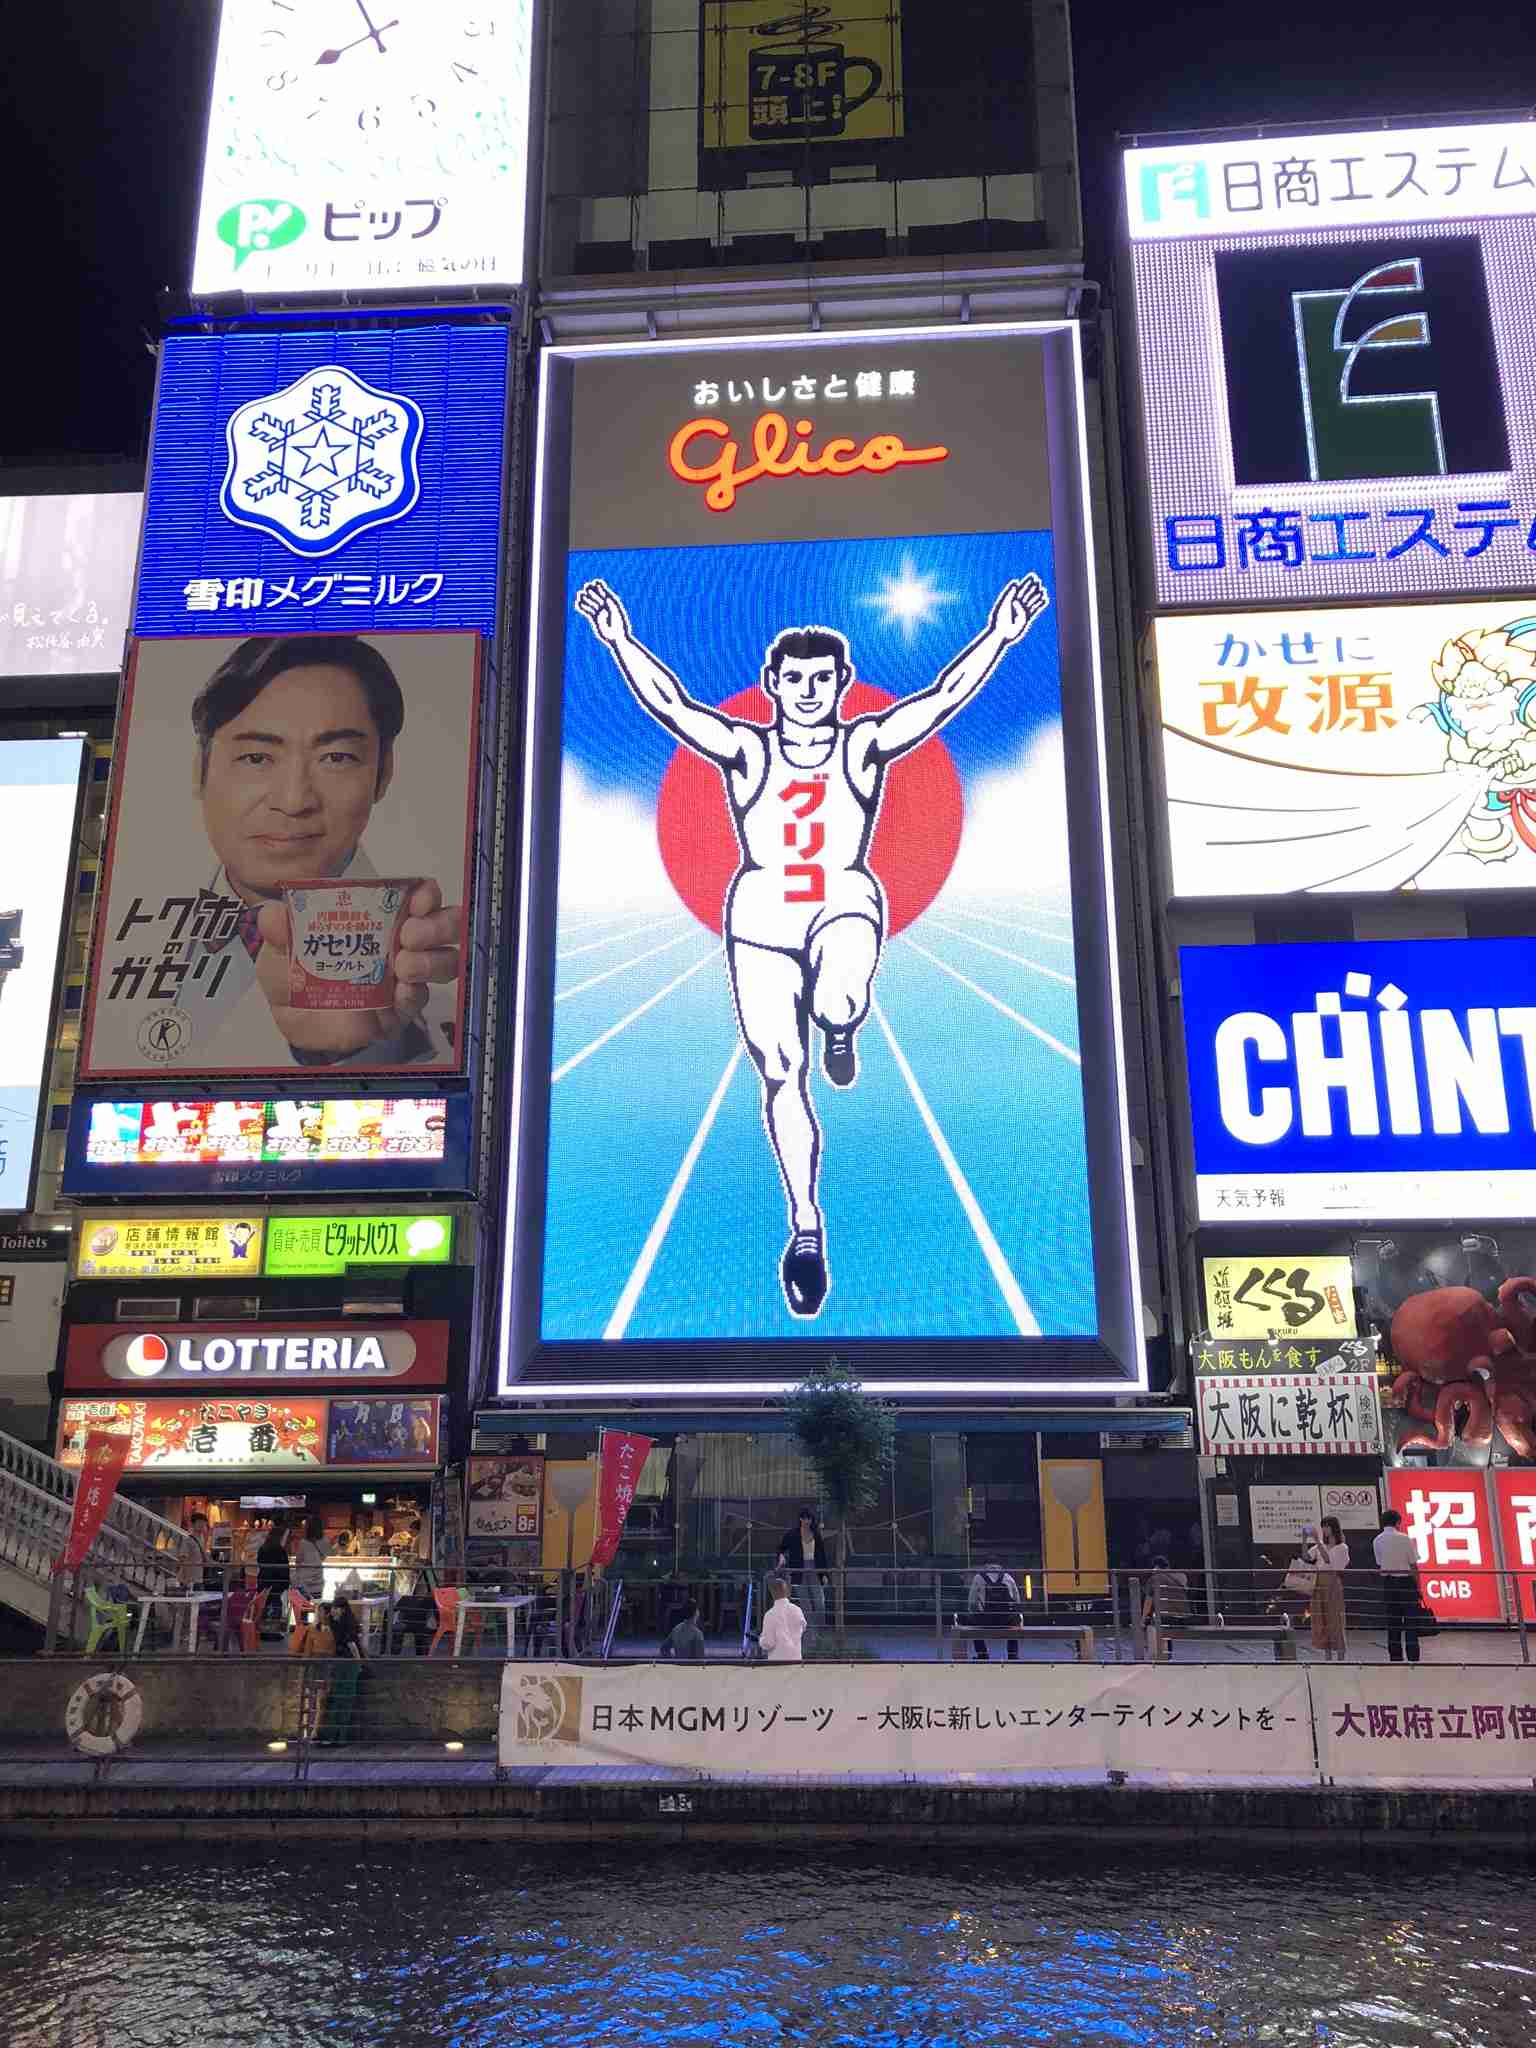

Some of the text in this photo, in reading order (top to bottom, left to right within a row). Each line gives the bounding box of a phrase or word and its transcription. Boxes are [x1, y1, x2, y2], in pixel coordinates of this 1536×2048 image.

[756, 61, 838, 90] 7-8F
[1223, 145, 1536, 213] 日商エステム
[324, 197, 449, 242] ピップ
[693, 369, 916, 405] おいしさと健康
[669, 411, 950, 511] Glico
[1165, 500, 1536, 571] 日商エステ
[183, 573, 444, 611] 雪印メグミルク
[1199, 671, 1399, 738] 改源
[778, 772, 829, 903] グリコ
[115, 896, 240, 943] トクホ
[163, 942, 183, 954] の
[315, 960, 366, 972] ヨーグルト
[107, 955, 232, 1000] ガセリ
[1216, 1187, 1286, 1208] 天気予報
[0, 1234, 48, 1249] Toilets
[125, 1226, 220, 1242] 店舗情報館
[325, 1221, 400, 1257] ピタットハウス
[1233, 1267, 1326, 1328] くくる
[178, 1336, 387, 1372] LOTTERIA
[1198, 1346, 1322, 1371] 大阪もんを食す
[1208, 1388, 1354, 1441] 大阪に乾杯
[519, 1515, 536, 1532] 8F
[1406, 1489, 1483, 1566] 招
[1426, 1579, 1473, 1599] CMB
[591, 1703, 835, 1733] 日本MGMリゾーツ
[1331, 1703, 1536, 1740] 大阪府立阿倍
